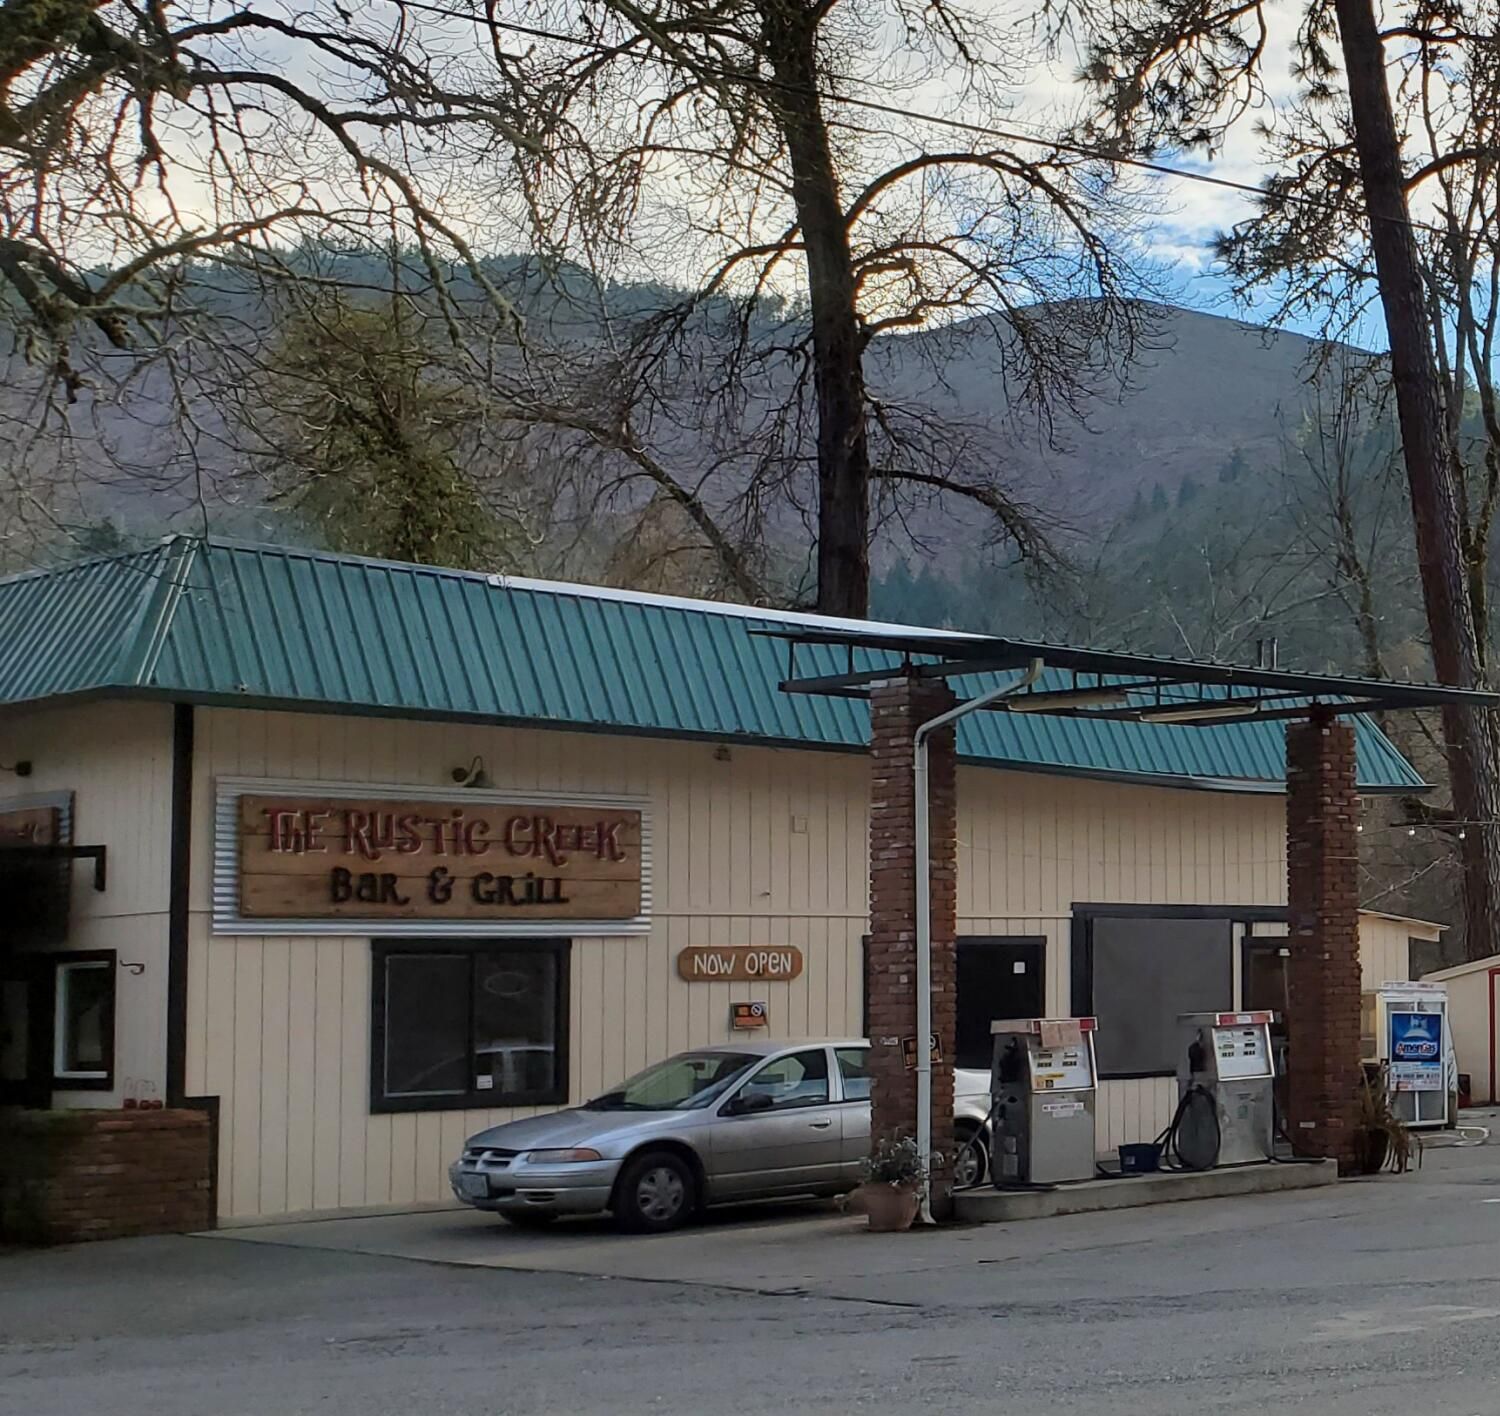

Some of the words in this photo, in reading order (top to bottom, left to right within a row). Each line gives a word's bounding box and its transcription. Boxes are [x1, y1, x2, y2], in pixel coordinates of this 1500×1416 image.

[344, 808, 490, 862] RUSTIC
[505, 816, 626, 867] CREEK
[428, 866, 456, 904] &
[694, 953, 736, 975] NOW
[745, 952, 791, 975] OPEN
